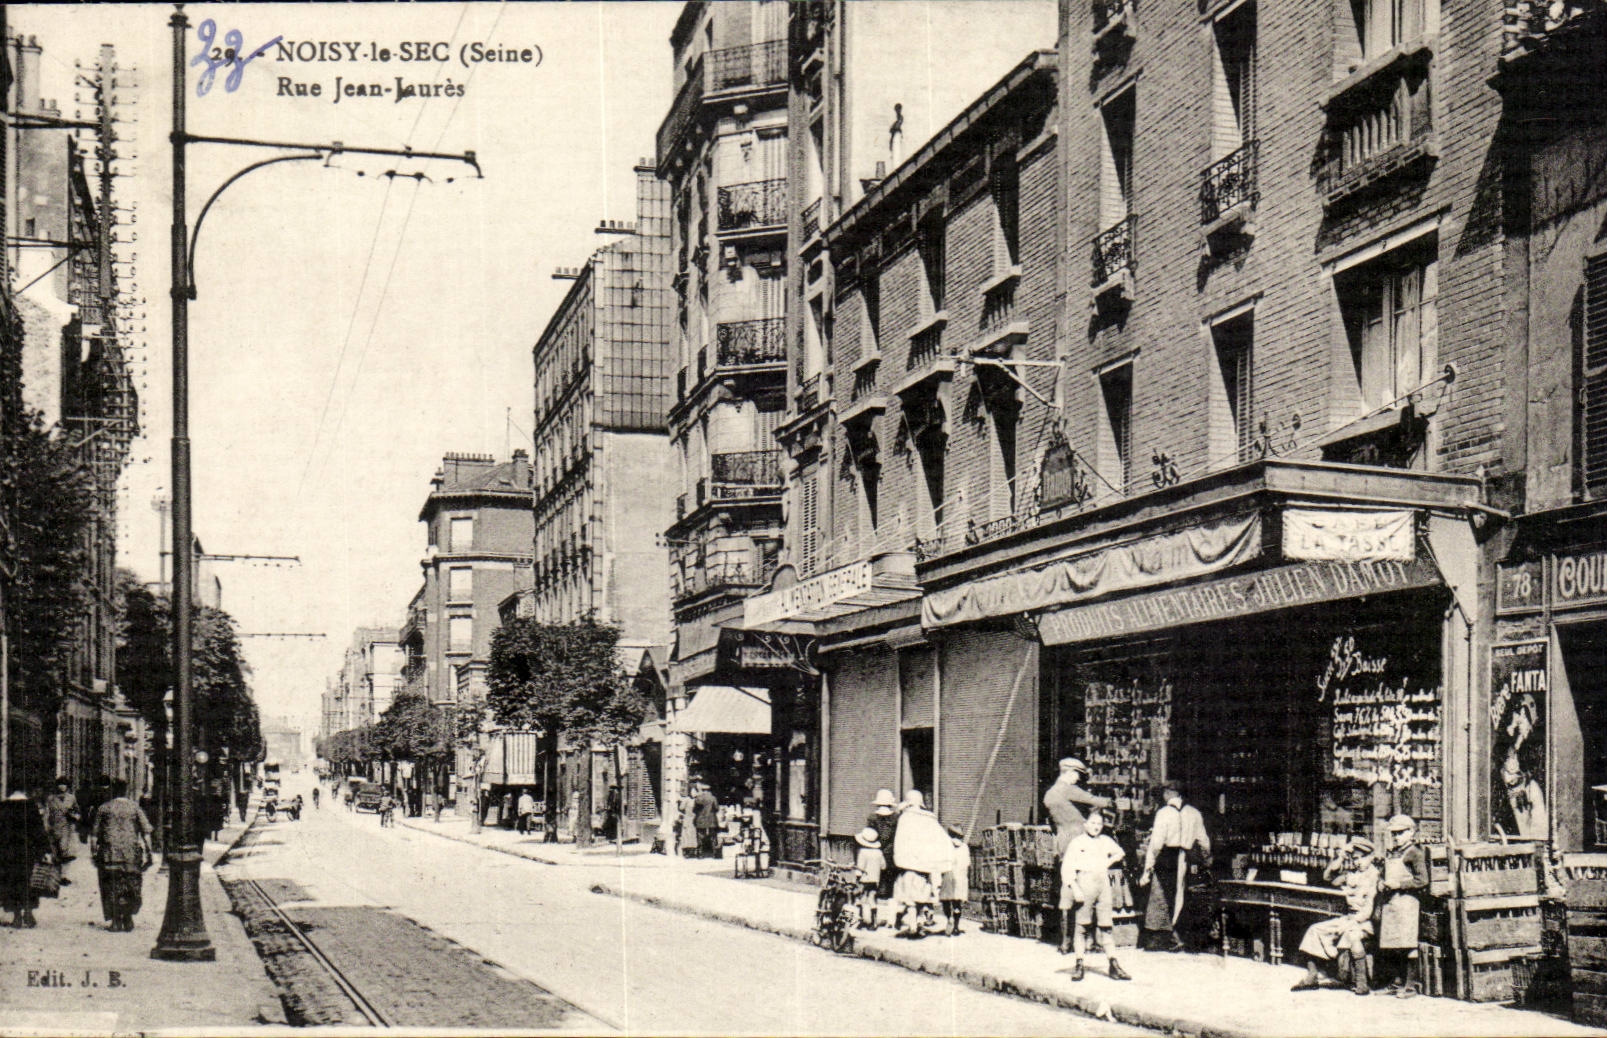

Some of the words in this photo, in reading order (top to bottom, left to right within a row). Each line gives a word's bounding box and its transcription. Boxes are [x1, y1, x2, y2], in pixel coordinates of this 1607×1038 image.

[1512, 572, 1532, 599] 78
[1049, 604, 1125, 640] PRODUITS
[1127, 581, 1247, 628] ALIMENTAIRES
[1252, 564, 1327, 606] JULIEN
[1511, 669, 1547, 694] FANTA
